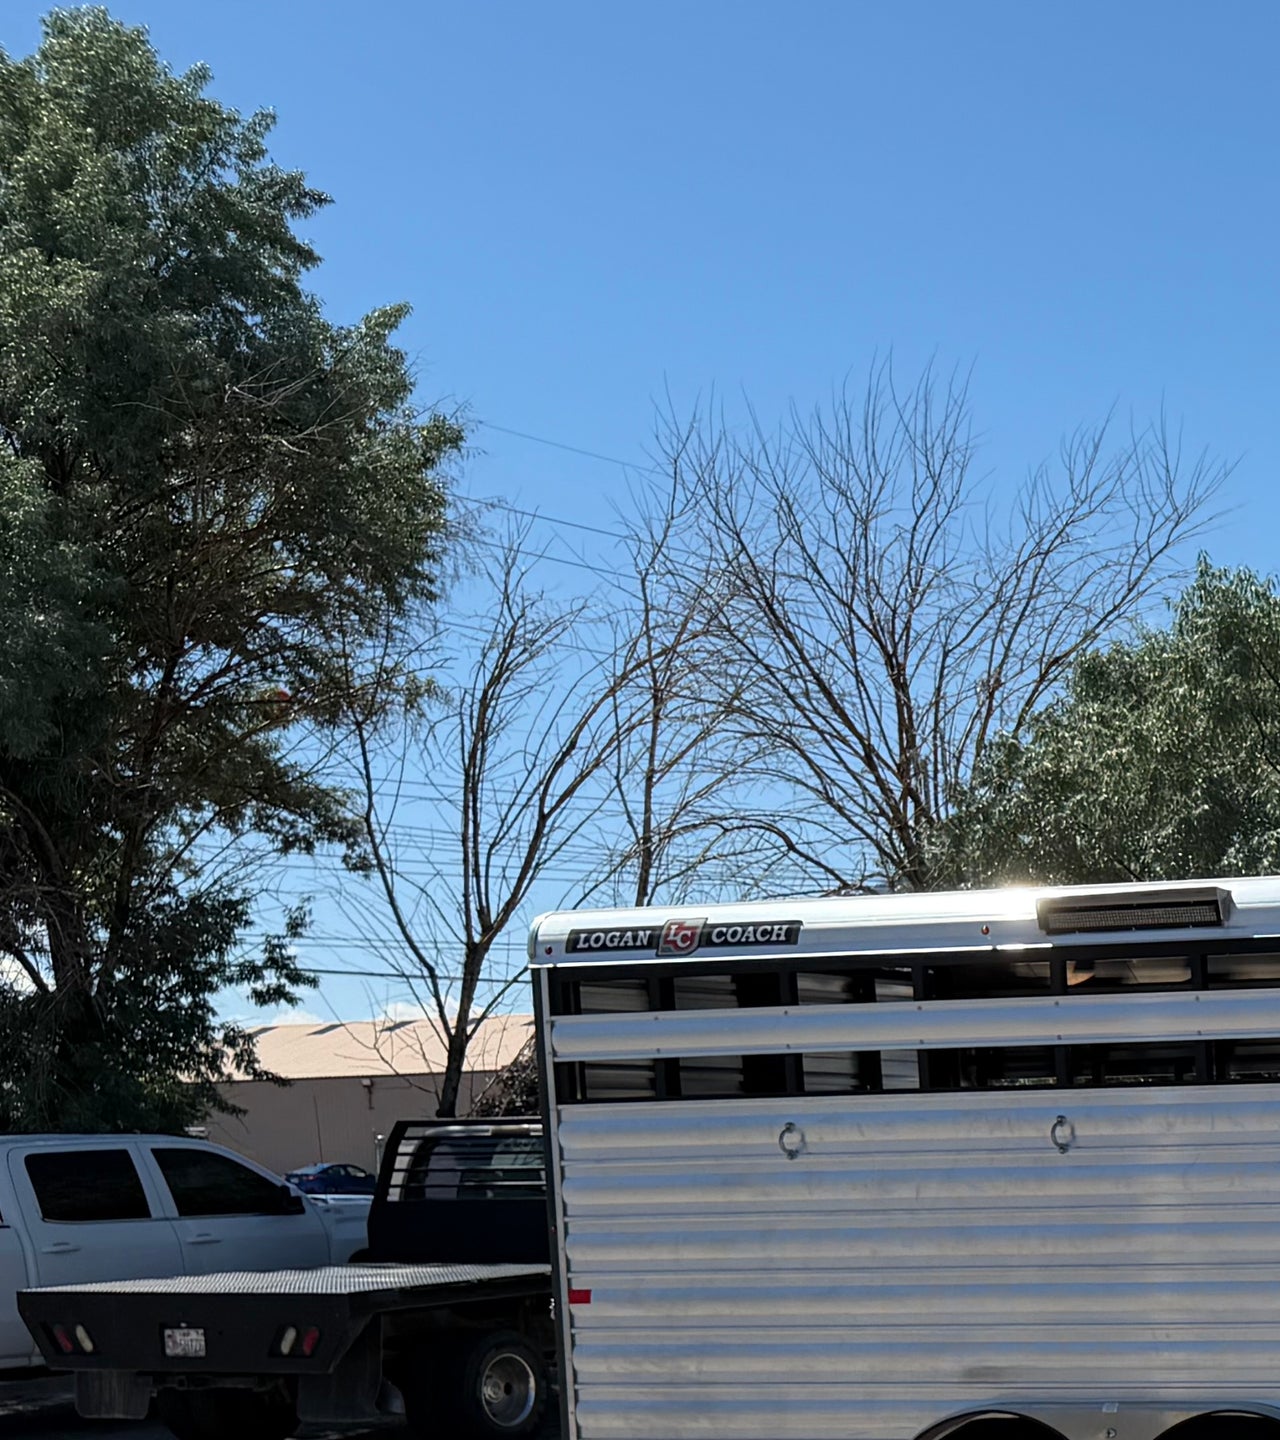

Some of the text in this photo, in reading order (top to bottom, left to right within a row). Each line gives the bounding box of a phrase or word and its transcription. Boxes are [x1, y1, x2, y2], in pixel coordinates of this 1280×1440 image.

[577, 924, 789, 949] LOGAN LC COACH
